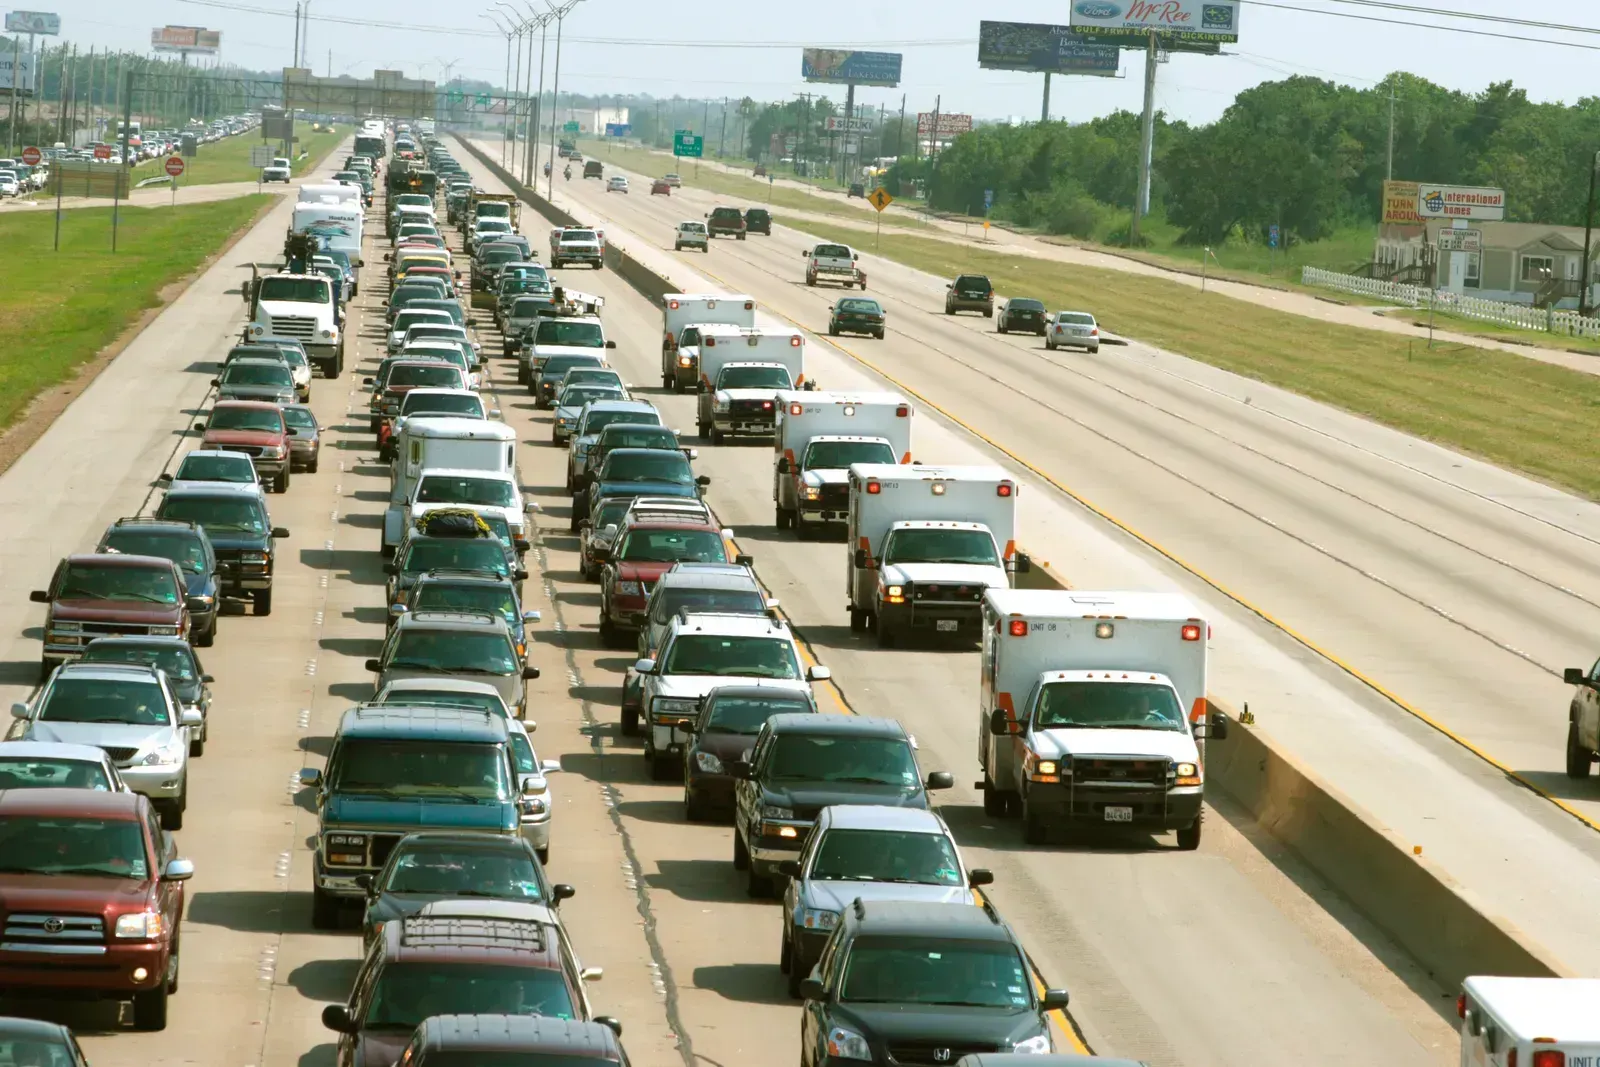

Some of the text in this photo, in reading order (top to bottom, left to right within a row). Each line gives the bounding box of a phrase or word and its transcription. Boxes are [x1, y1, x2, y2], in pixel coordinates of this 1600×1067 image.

[1083, 4, 1112, 16] Ford
[1125, 0, 1191, 23] McRee
[1181, 32, 1235, 42] DICKINSON
[836, 120, 872, 129] SUZUKI
[1387, 199, 1413, 209] TURN
[1443, 205, 1471, 215] homes
[1030, 623, 1057, 631] UNIT 08
